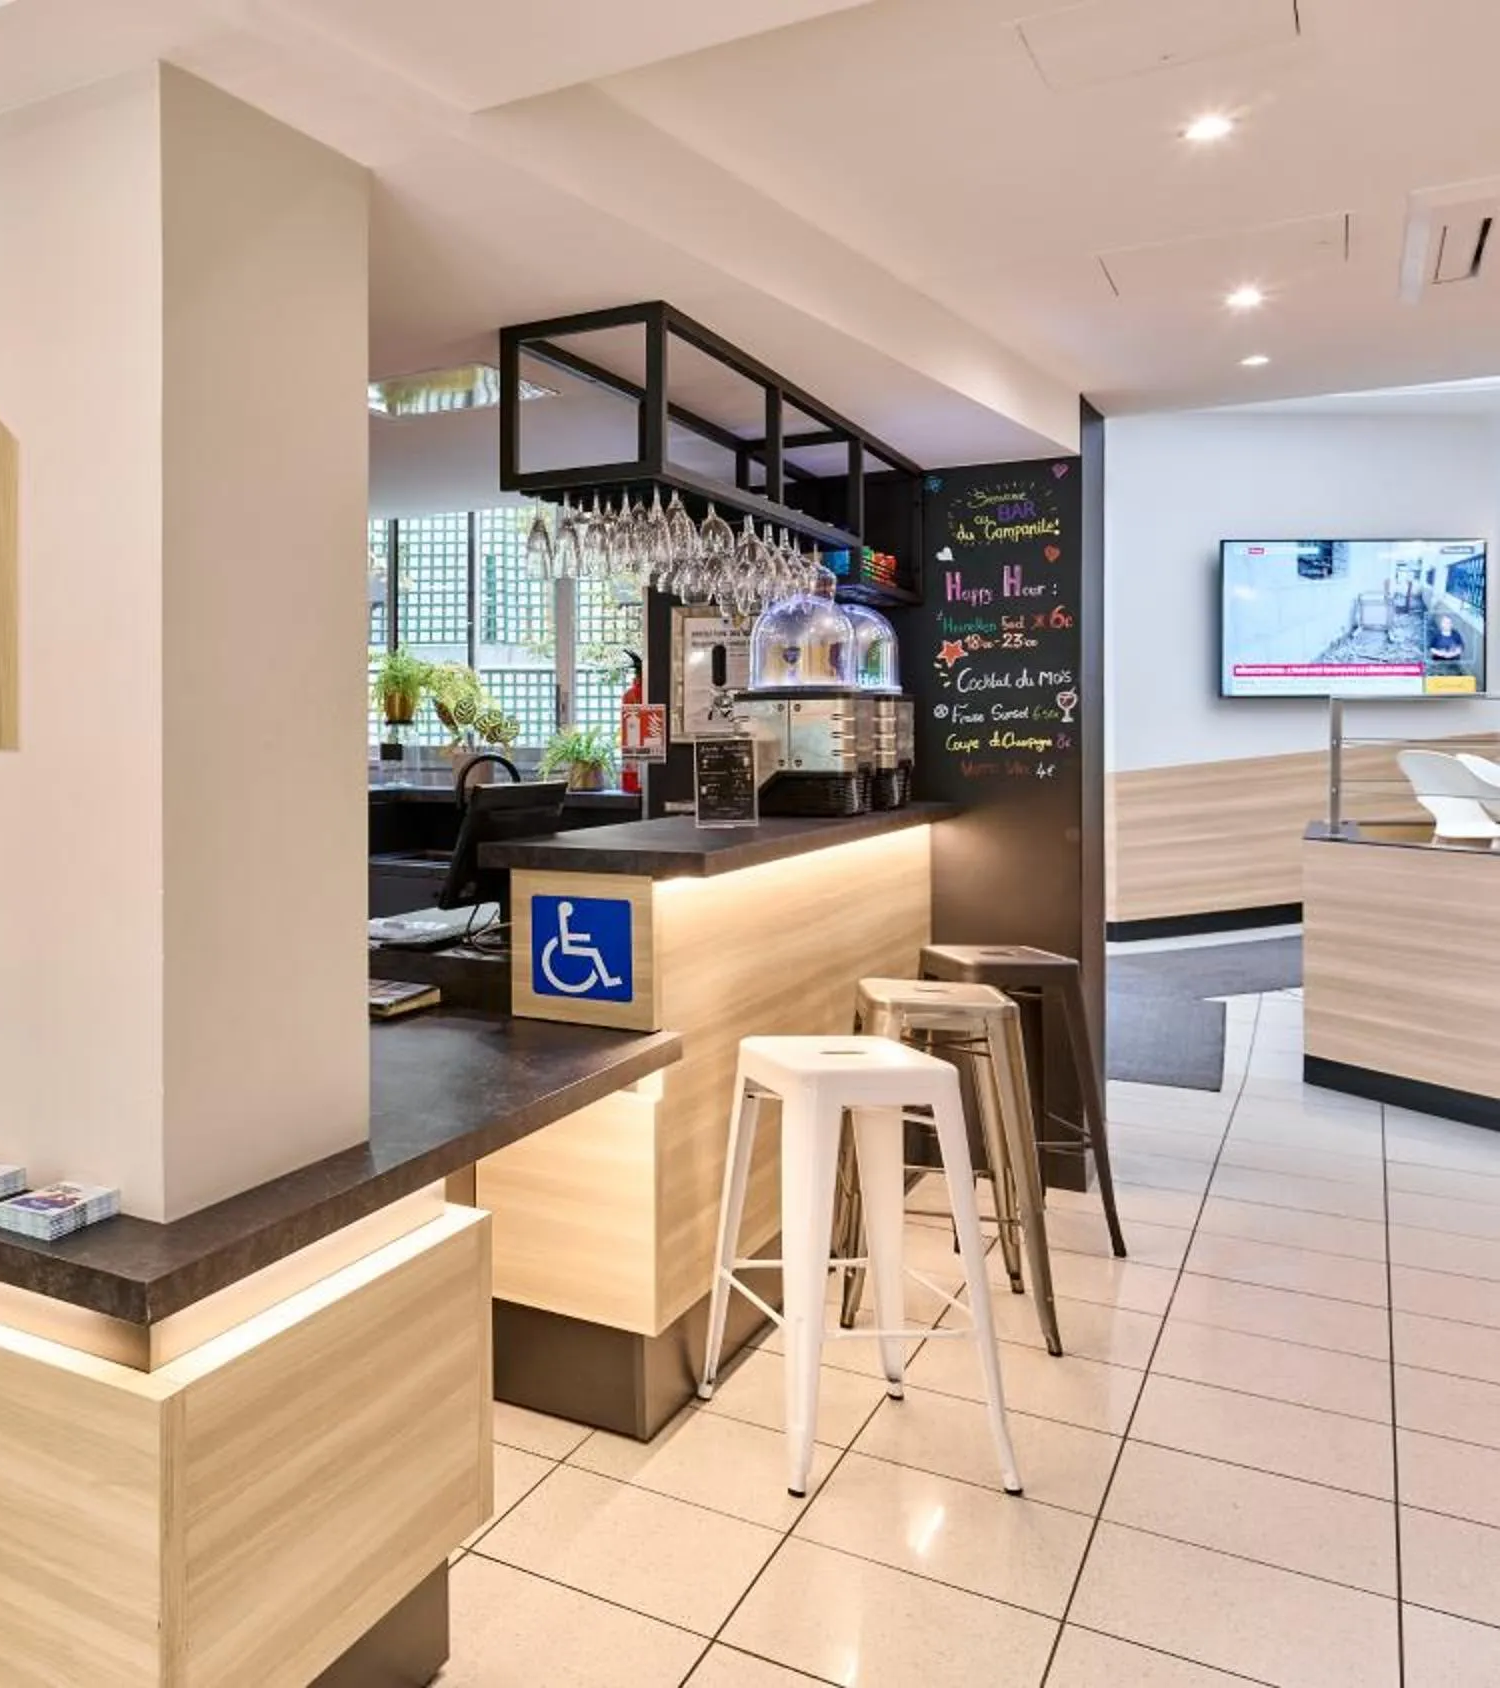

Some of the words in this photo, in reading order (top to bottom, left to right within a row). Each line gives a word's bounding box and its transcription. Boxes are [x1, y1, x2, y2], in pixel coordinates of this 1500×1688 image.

[997, 501, 1036, 521] BAR
[956, 523, 975, 541] du
[945, 571, 992, 607] Happy
[1015, 667, 1035, 689] du
